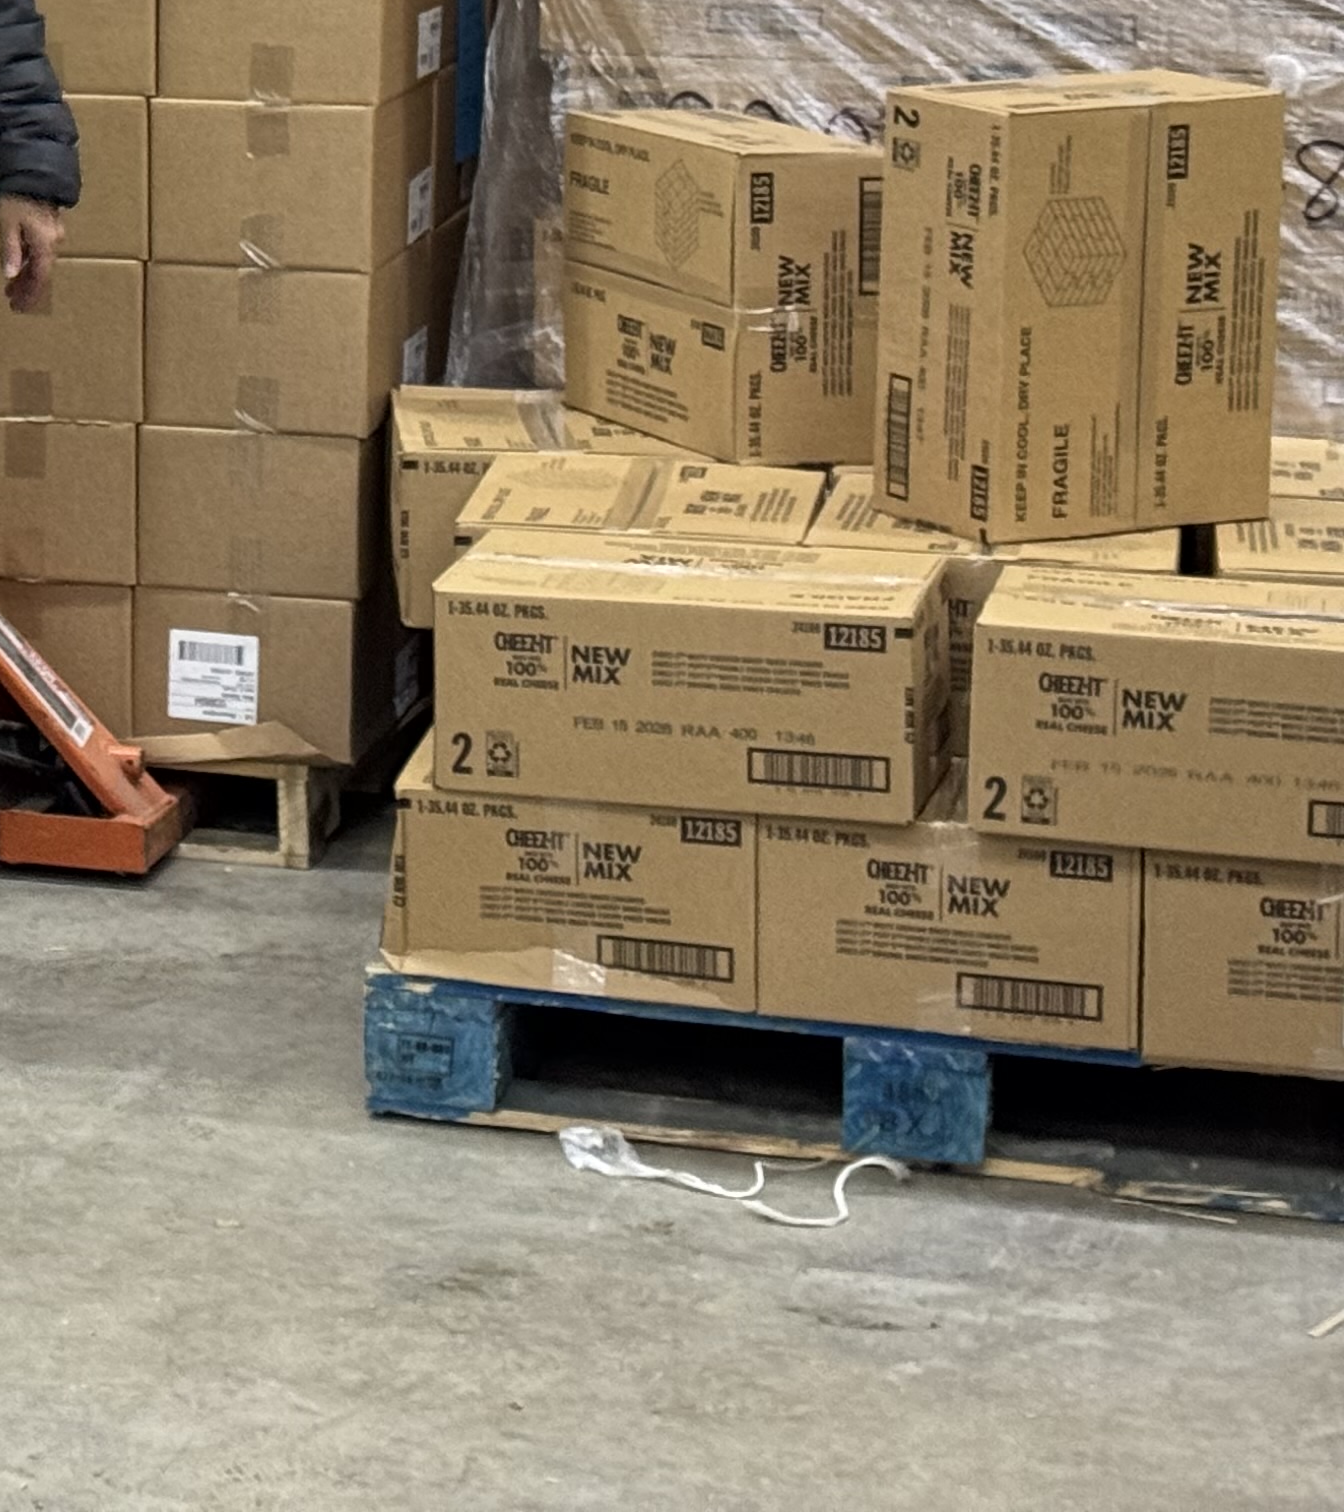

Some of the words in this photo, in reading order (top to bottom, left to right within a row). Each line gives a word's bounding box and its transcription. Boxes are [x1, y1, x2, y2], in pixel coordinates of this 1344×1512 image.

[893, 105, 920, 129] 2
[1169, 129, 1187, 175] 12185
[753, 176, 771, 221] 12185
[947, 231, 962, 279] MIX
[958, 231, 975, 291] NEW
[779, 255, 795, 307] NEW
[794, 263, 811, 306] MIX
[1186, 242, 1204, 305] NEW
[1204, 251, 1222, 303] MIX
[1019, 327, 1031, 377] PLACE
[1018, 382, 1029, 410] DRY
[1016, 464, 1028, 479] IN
[1052, 423, 1070, 519] FRAGILE
[1015, 481, 1027, 522] KEEP
[448, 600, 488, 617] 1-35.44
[492, 603, 512, 618] OZ.
[515, 603, 548, 620] PKGS.
[829, 626, 882, 649] 12185
[571, 644, 631, 669] NEW
[1059, 643, 1096, 661] PKGS.
[572, 664, 622, 686] MIX
[1121, 689, 1189, 711] NEW
[681, 724, 721, 739] RAA
[1122, 709, 1175, 732] MIX
[451, 732, 473, 775] 2
[418, 799, 458, 816] 1-35.44
[983, 776, 1008, 822] 2
[685, 820, 738, 843] 12185
[583, 842, 642, 864] NEW
[584, 861, 633, 882] MIX
[1055, 854, 1108, 879] 12185
[947, 874, 1011, 899] NEW
[949, 896, 999, 918] MIX
